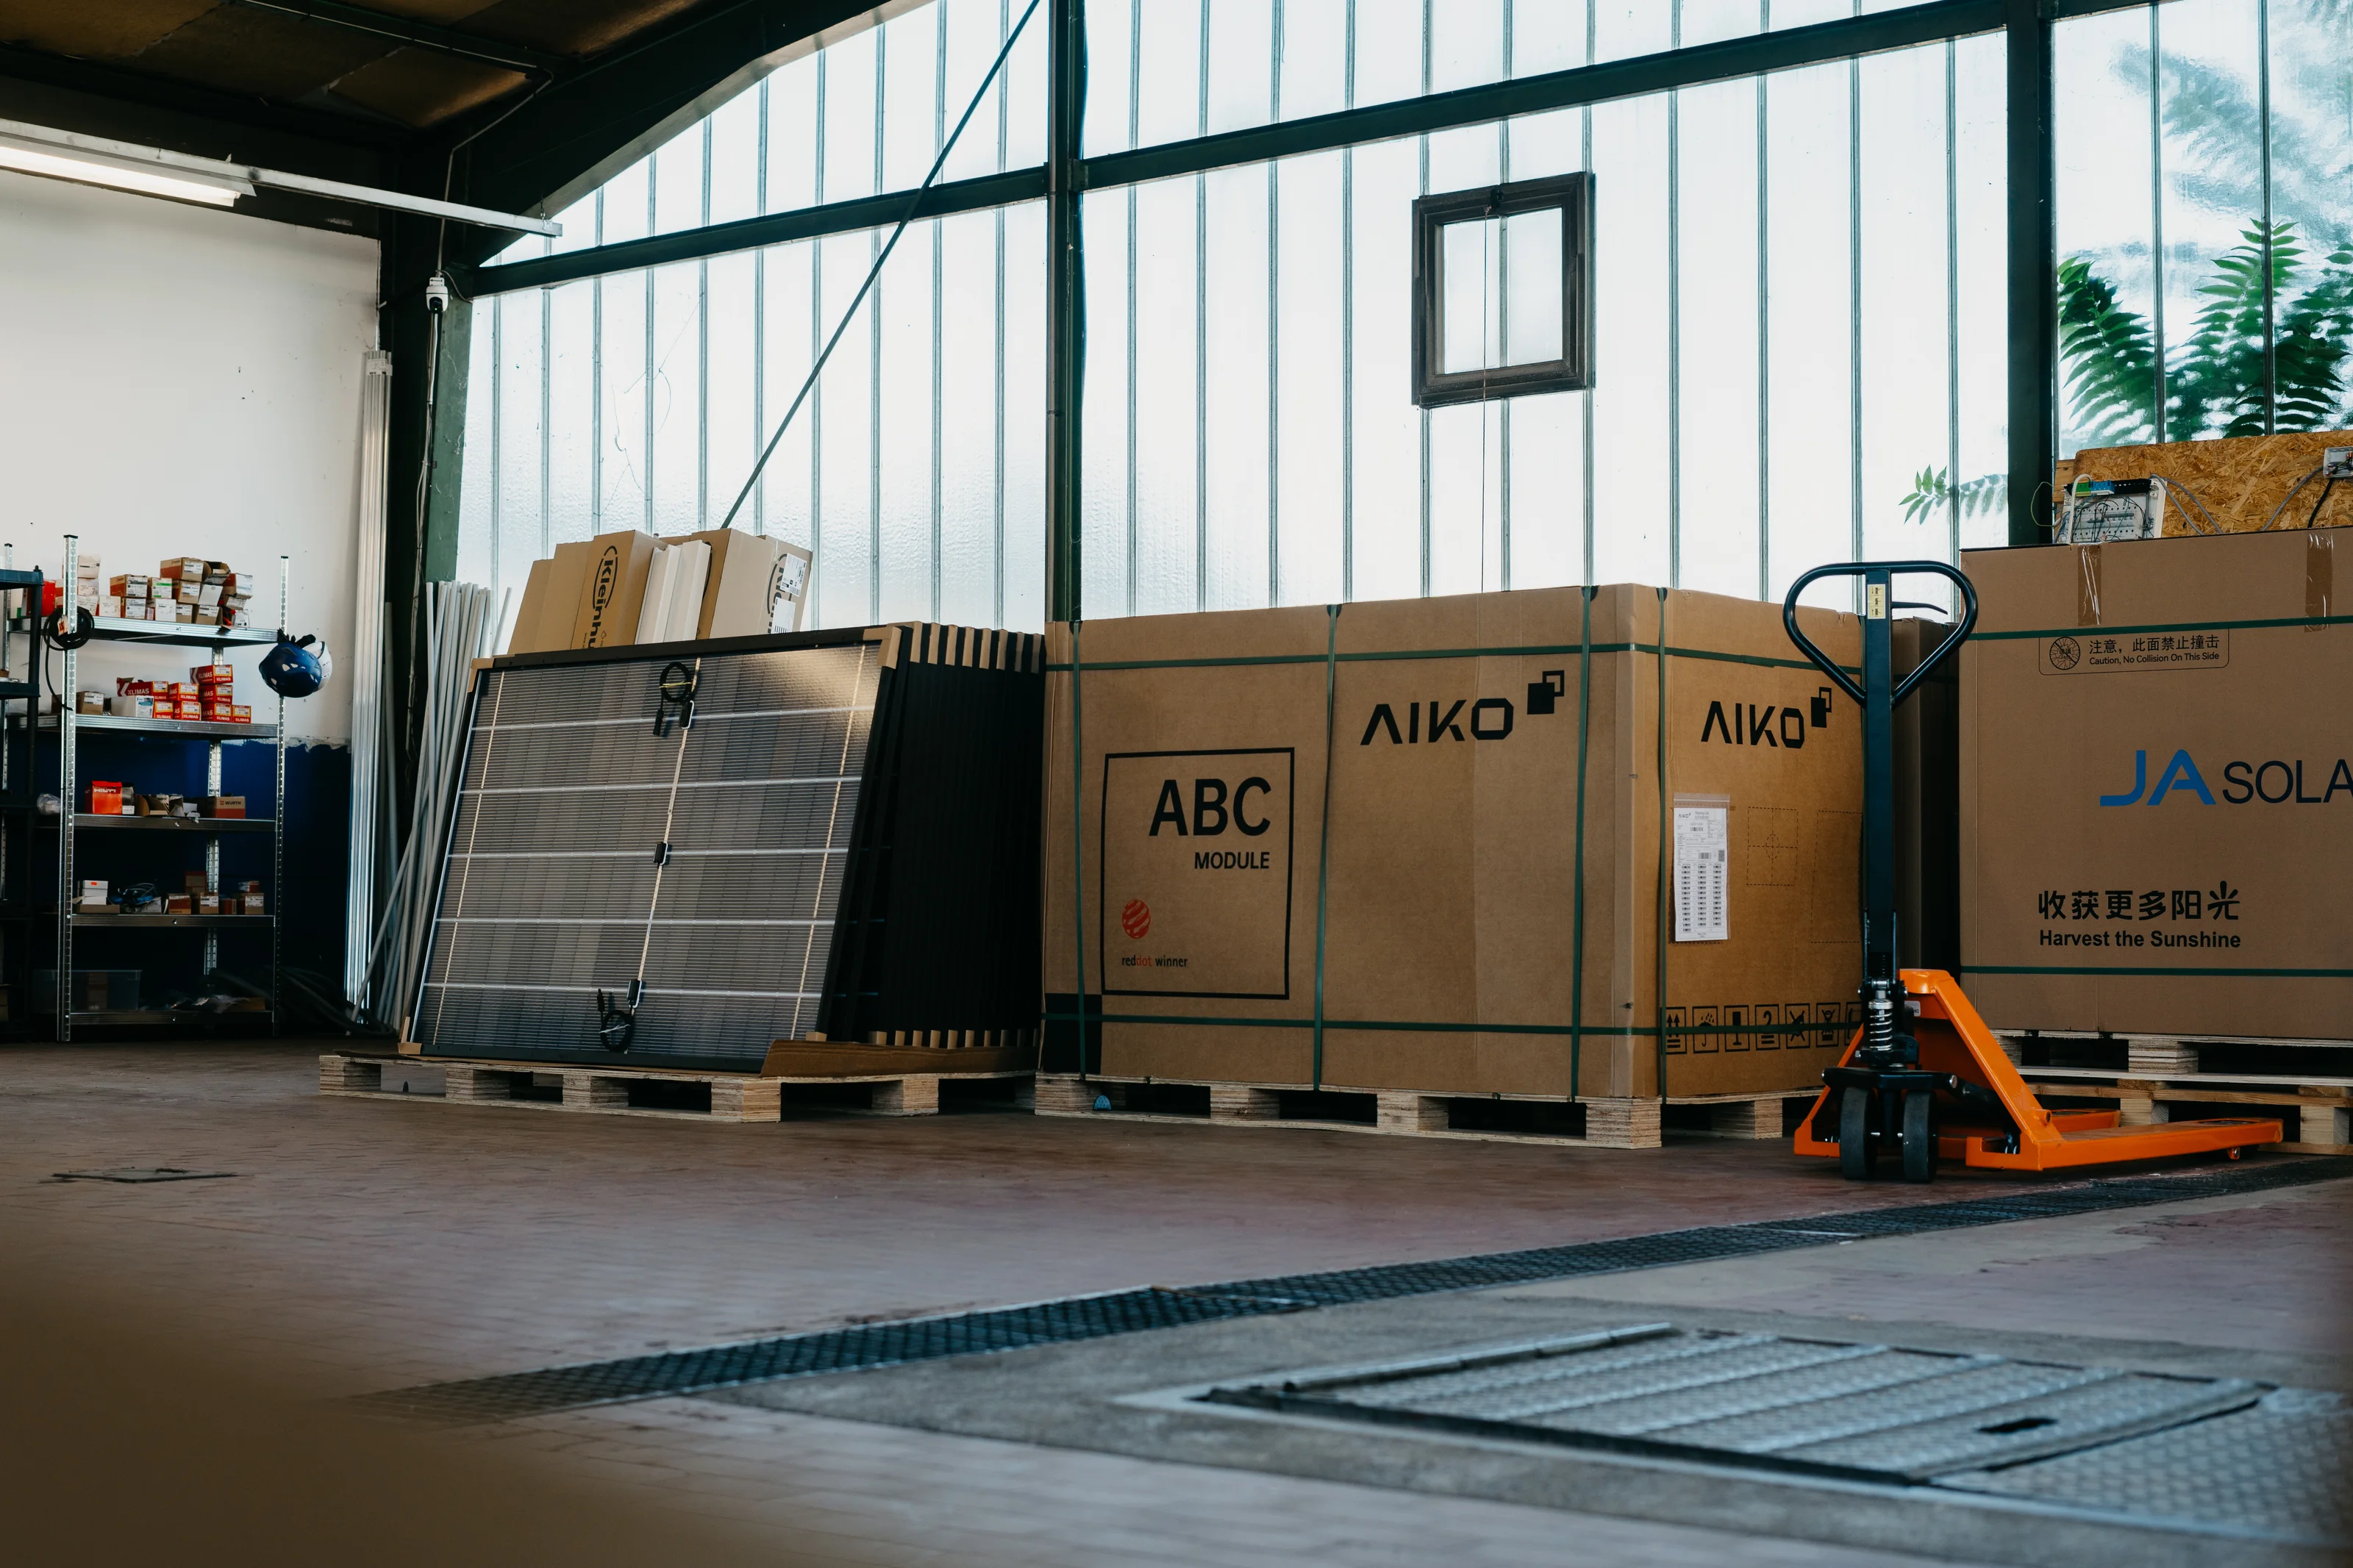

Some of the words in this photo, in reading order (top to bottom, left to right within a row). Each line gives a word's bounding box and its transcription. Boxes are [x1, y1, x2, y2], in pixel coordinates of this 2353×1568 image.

[2089, 634, 2219, 654] 注意，此面禁止撞击
[2089, 656, 2121, 665] Caution,
[2123, 656, 2135, 664] No
[2136, 654, 2168, 663] Collision
[2185, 653, 2200, 661] This
[2202, 651, 2219, 660] Side
[1360, 697, 1514, 745] AIKO
[1701, 700, 1804, 749] AIKO
[2100, 749, 2216, 806] JA
[2222, 759, 2353, 803] SOLA
[1149, 776, 1271, 837] ABC
[1193, 851, 1270, 870] MODULE
[2038, 881, 2240, 920] 收获更多阳光
[2040, 929, 2110, 946] Harvest
[2115, 930, 2144, 947] the
[2150, 930, 2240, 948] Sunshine
[1154, 955, 1188, 967] winner
